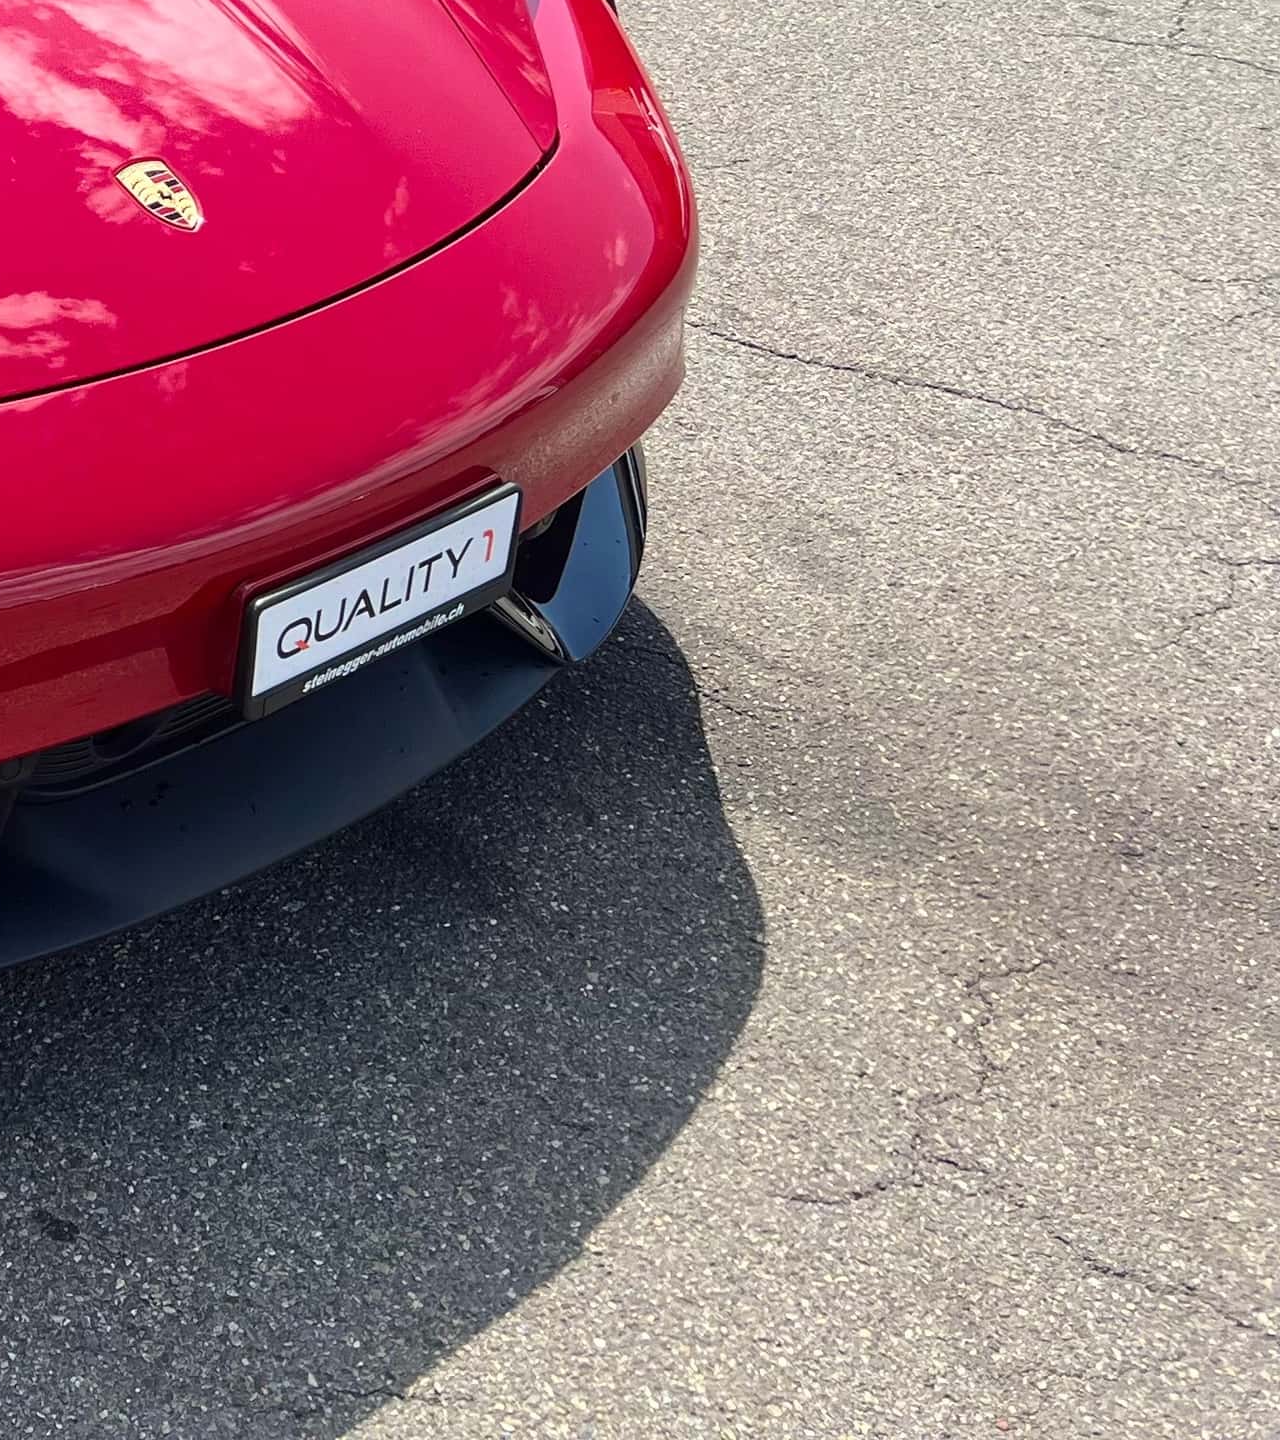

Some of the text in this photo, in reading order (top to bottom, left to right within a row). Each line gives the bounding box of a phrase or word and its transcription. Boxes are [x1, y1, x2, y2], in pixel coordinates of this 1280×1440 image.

[277, 528, 496, 659] QUALITY 1
[302, 602, 465, 693] steinegger-automobile.ch
